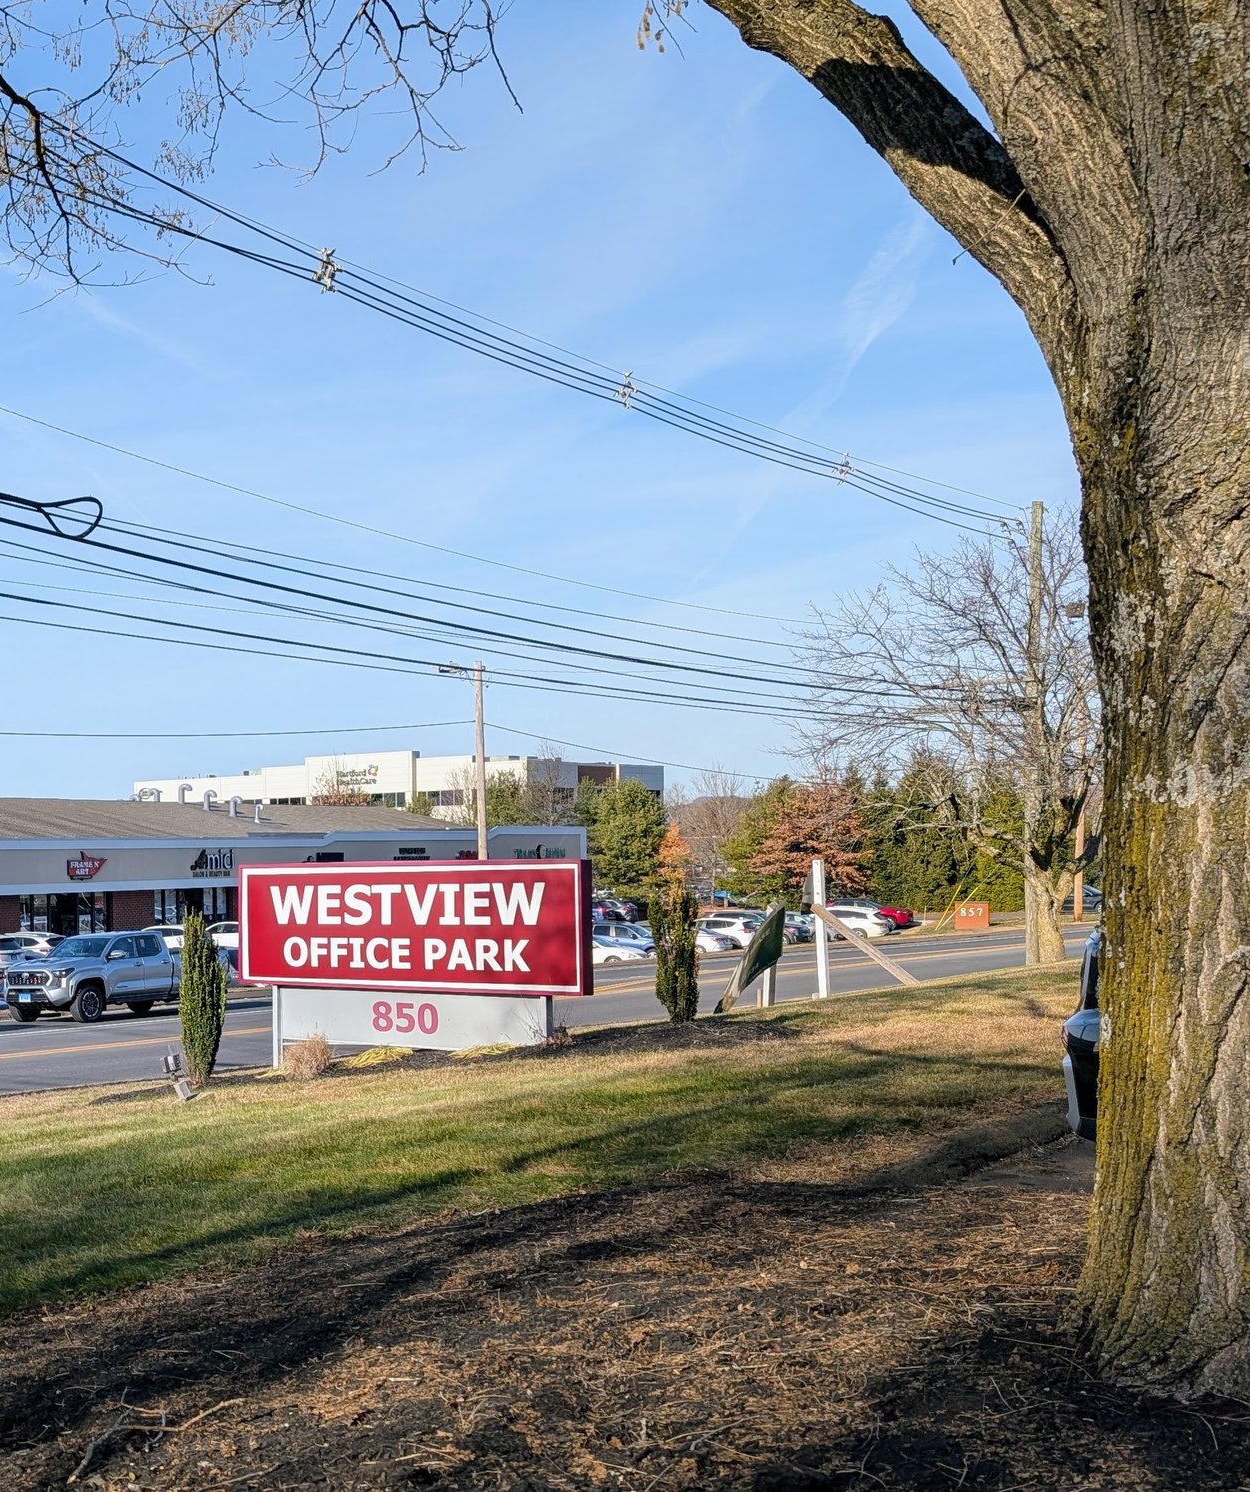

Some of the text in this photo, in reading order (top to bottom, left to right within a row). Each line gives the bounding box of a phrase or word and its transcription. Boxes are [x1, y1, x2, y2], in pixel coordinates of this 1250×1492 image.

[190, 848, 235, 870] Amici
[270, 883, 545, 925] WESTVIEW
[960, 907, 983, 917] 857
[284, 937, 530, 971] OFFICE PARK
[372, 1001, 438, 1034] 850
